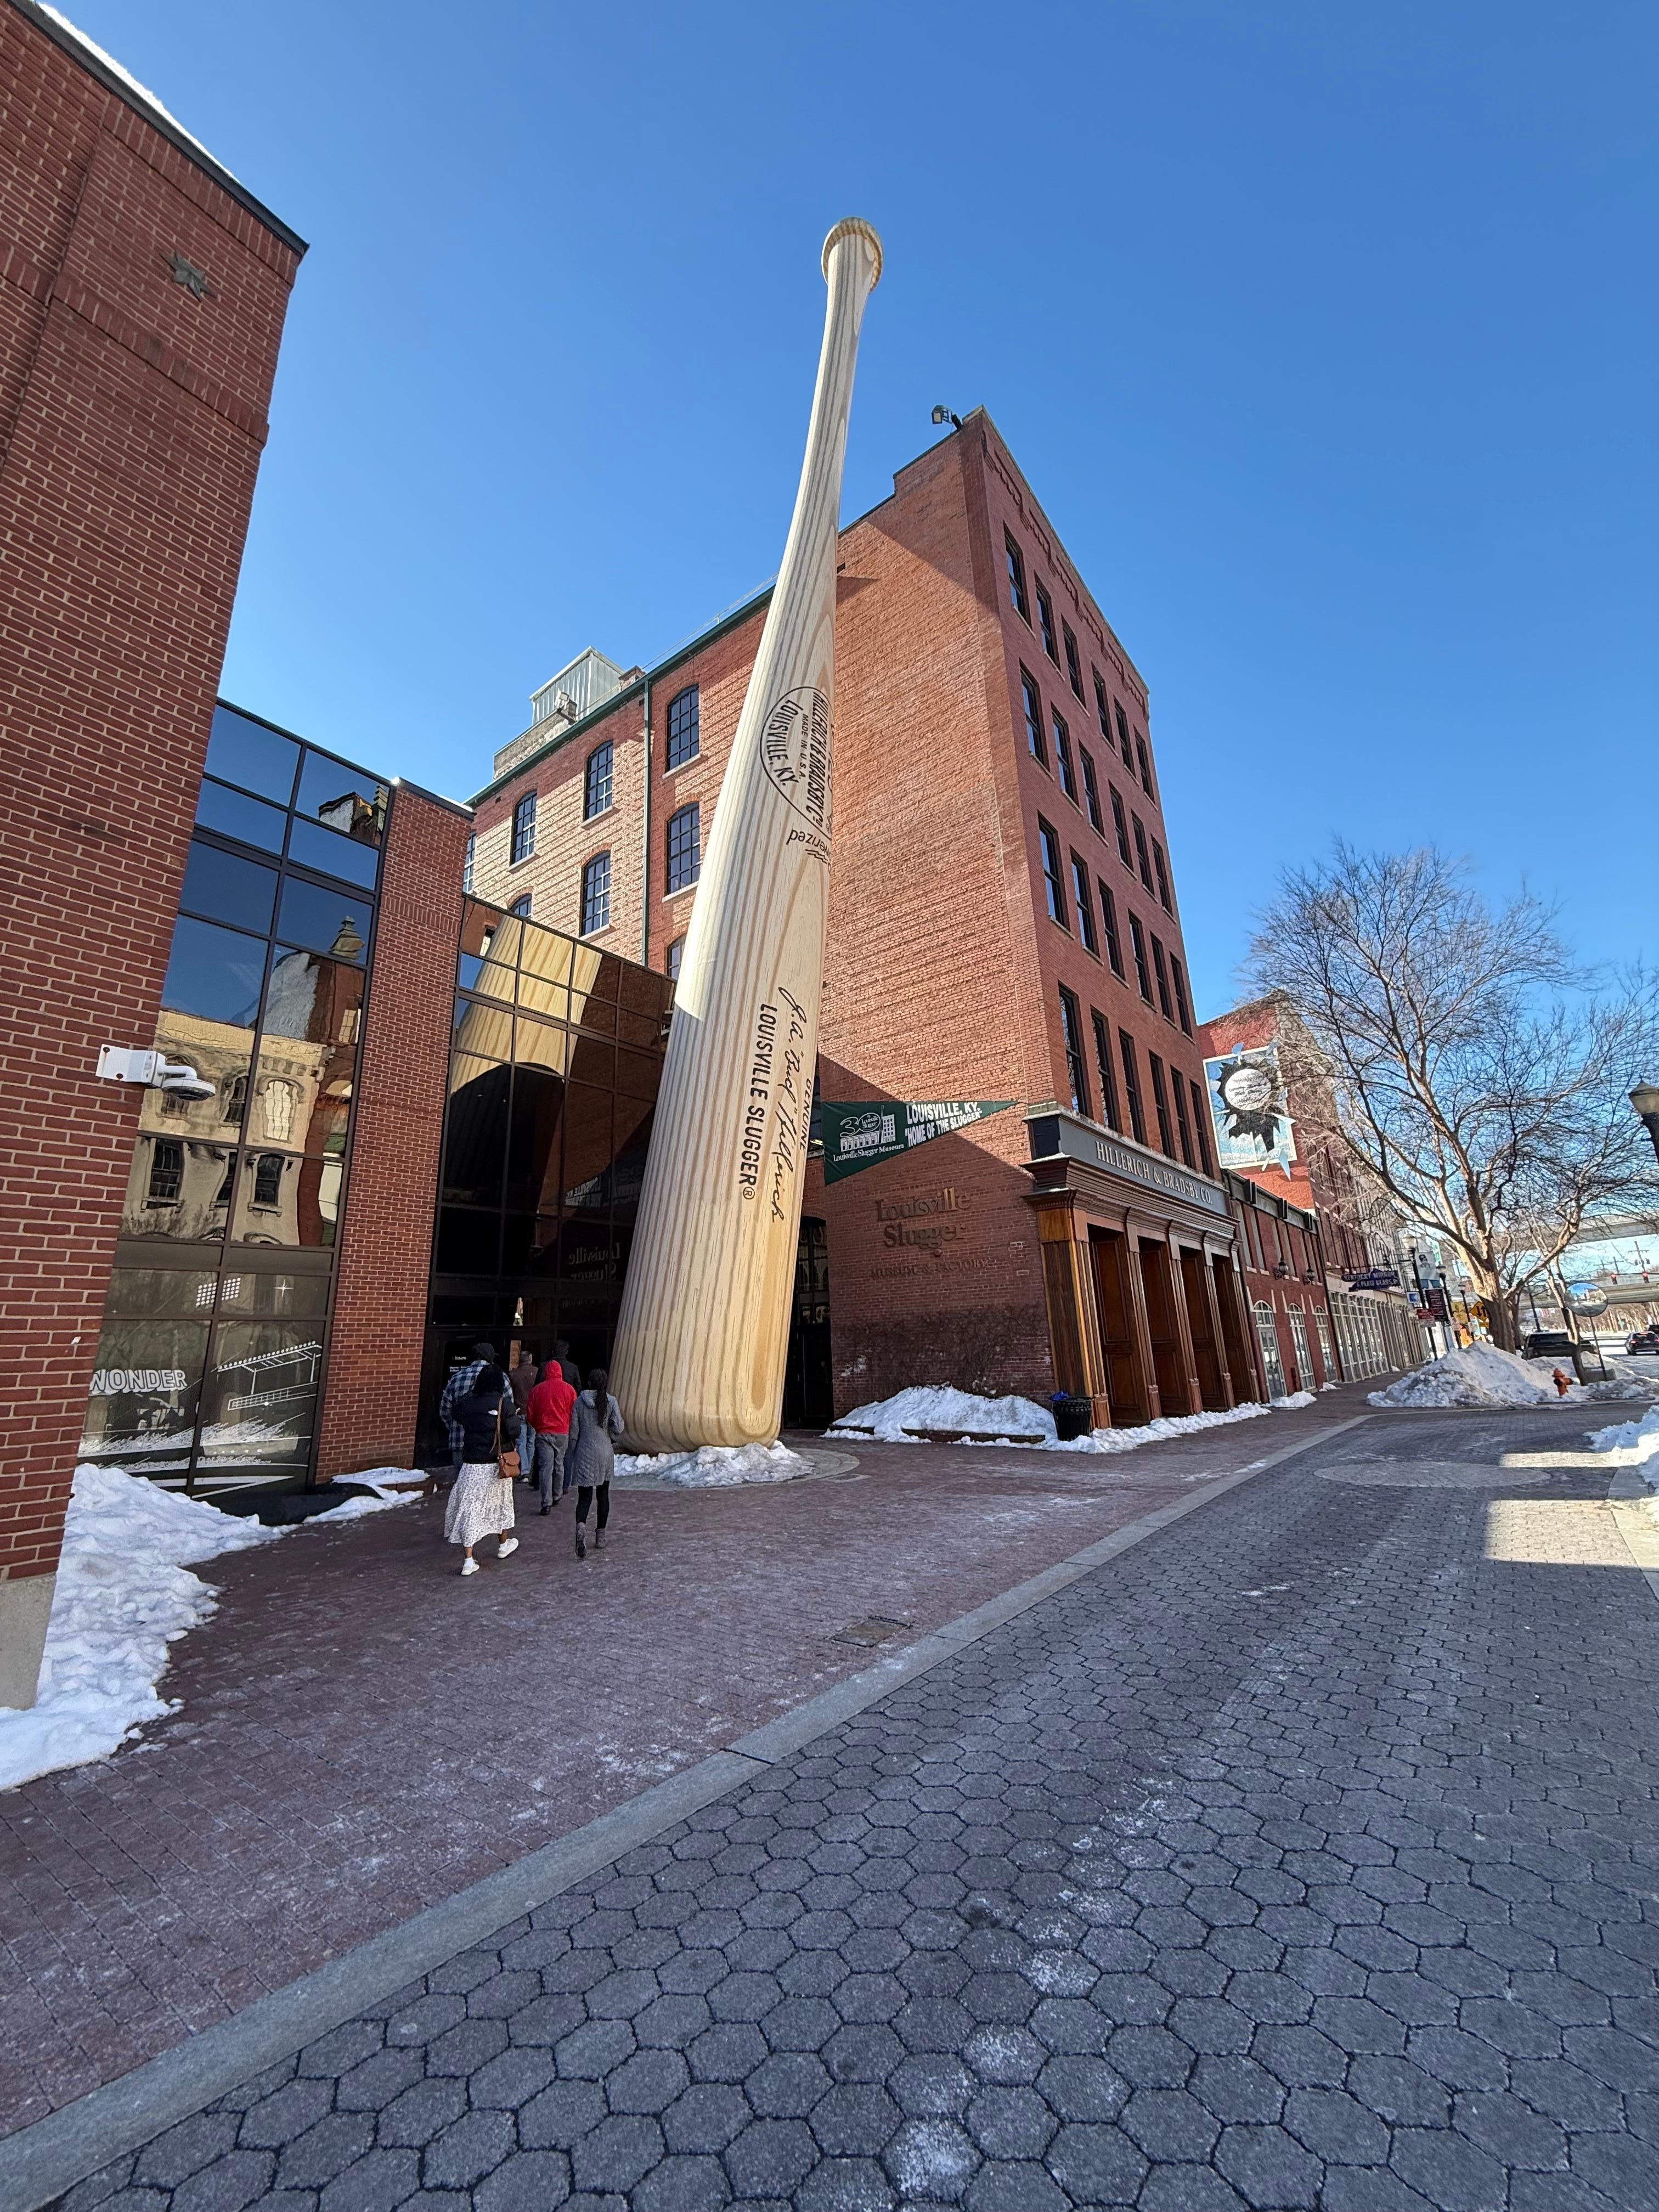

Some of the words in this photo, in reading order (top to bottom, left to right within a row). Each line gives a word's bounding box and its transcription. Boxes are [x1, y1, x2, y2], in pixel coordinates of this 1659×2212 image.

[766, 699, 804, 765] LOUISVILLE,
[811, 691, 828, 752] HILLERICH
[800, 740, 808, 749] IN
[810, 743, 826, 760] &
[774, 767, 799, 786] KY.
[799, 753, 807, 780] U.S.A.
[806, 752, 826, 815] BRADSBY
[751, 1003, 777, 1100] LOUISVILLE
[800, 1077, 812, 1151] GENUINE
[964, 1102, 981, 1114] KY.
[926, 1122, 935, 1139] OF
[935, 1119, 950, 1135] THE
[833, 1150, 858, 1162] Louisville
[857, 1148, 878, 1157] Slugger
[879, 1144, 904, 1153] Museum
[1096, 1141, 1150, 1180] HILLERICH
[1153, 1167, 1161, 1184] &
[1163, 1171, 1199, 1199] BRADSBY
[1200, 1187, 1213, 1205] CO.
[876, 1186, 970, 1221] Louisville
[884, 1222, 967, 1249] Slugger
